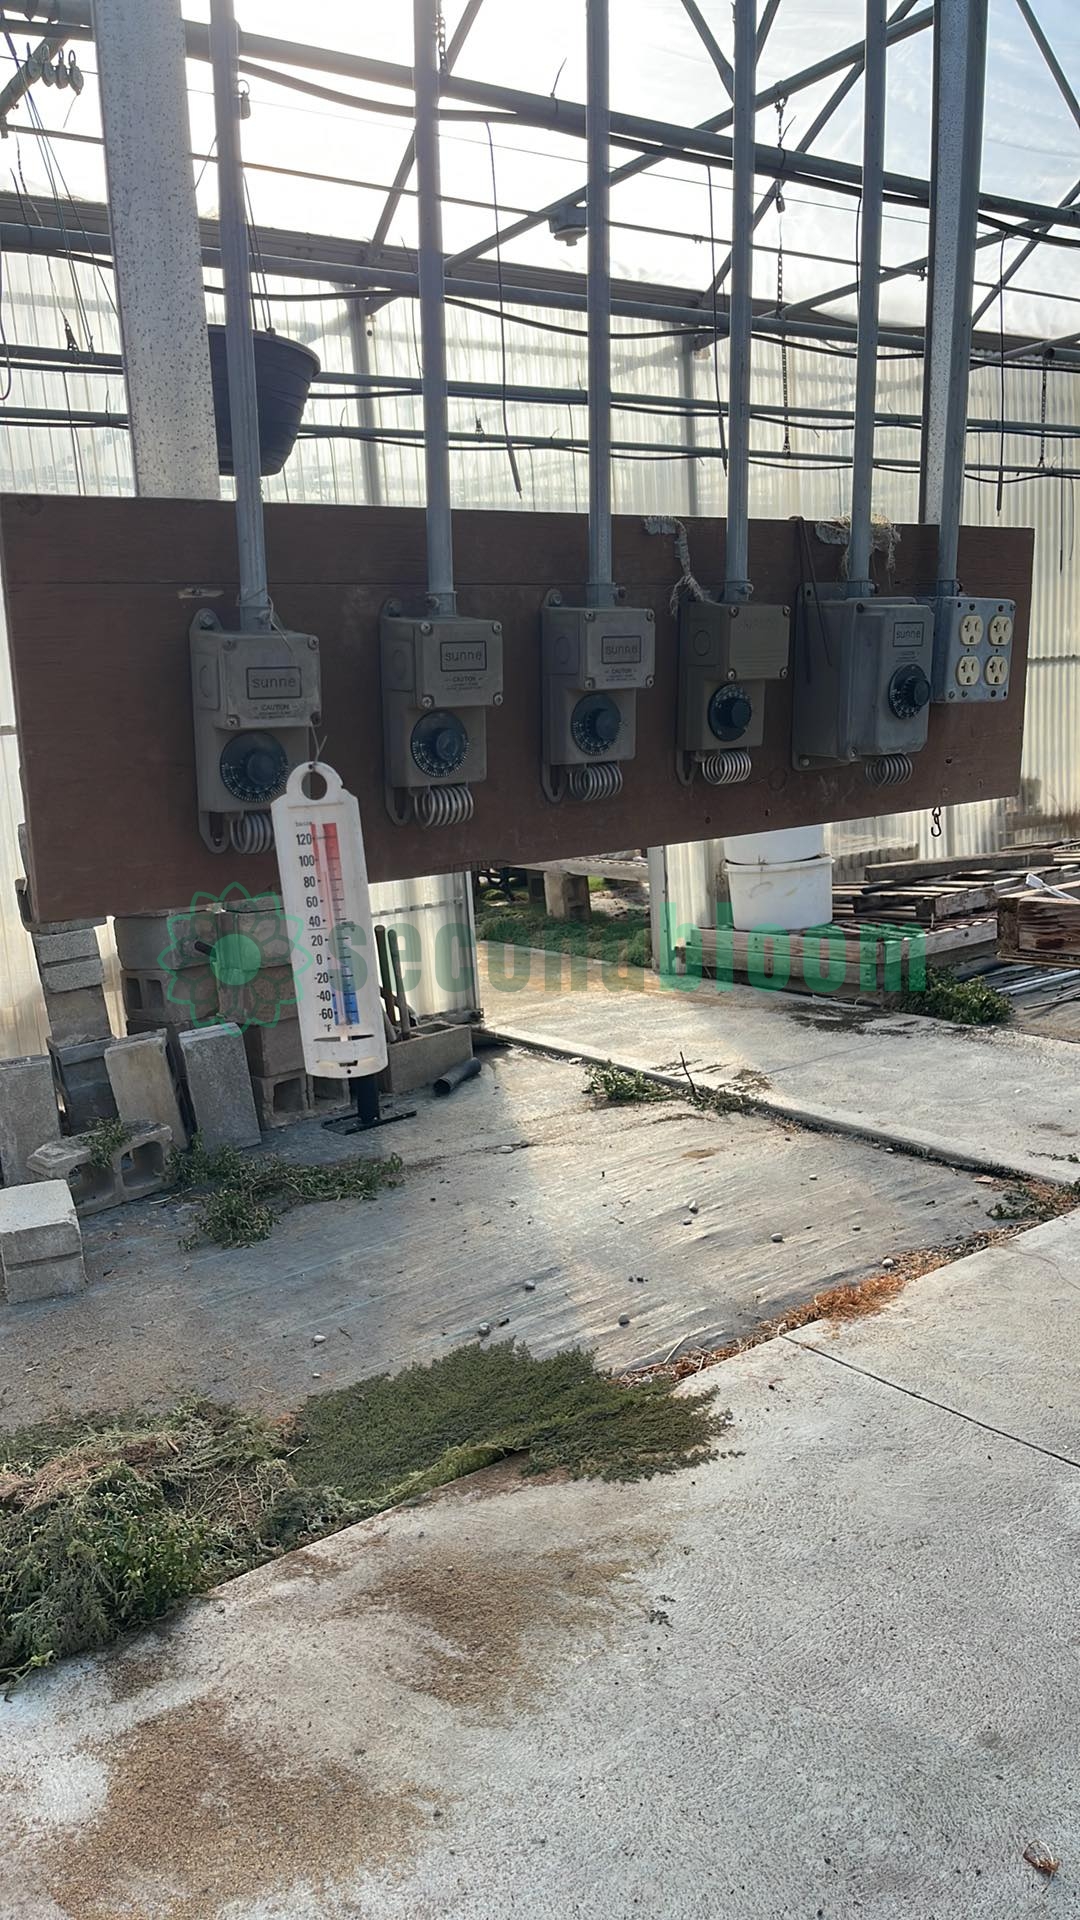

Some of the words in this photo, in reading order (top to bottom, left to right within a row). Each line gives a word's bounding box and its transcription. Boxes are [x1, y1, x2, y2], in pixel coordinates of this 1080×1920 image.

[896, 630, 921, 640] sunne
[444, 650, 482, 662] sunne
[605, 644, 638, 656] sunne
[251, 675, 296, 689] sunne
[296, 833, 311, 846] 120
[299, 855, 315, 868] 100
[304, 876, 316, 888] 80
[306, 896, 318, 908] 60
[309, 916, 321, 928] 40
[311, 935, 323, 947] 20
[316, 954, 323, 965] 0
[314, 972, 329, 984] -20
[316, 990, 331, 1002] -40
[318, 1008, 334, 1020] -60
